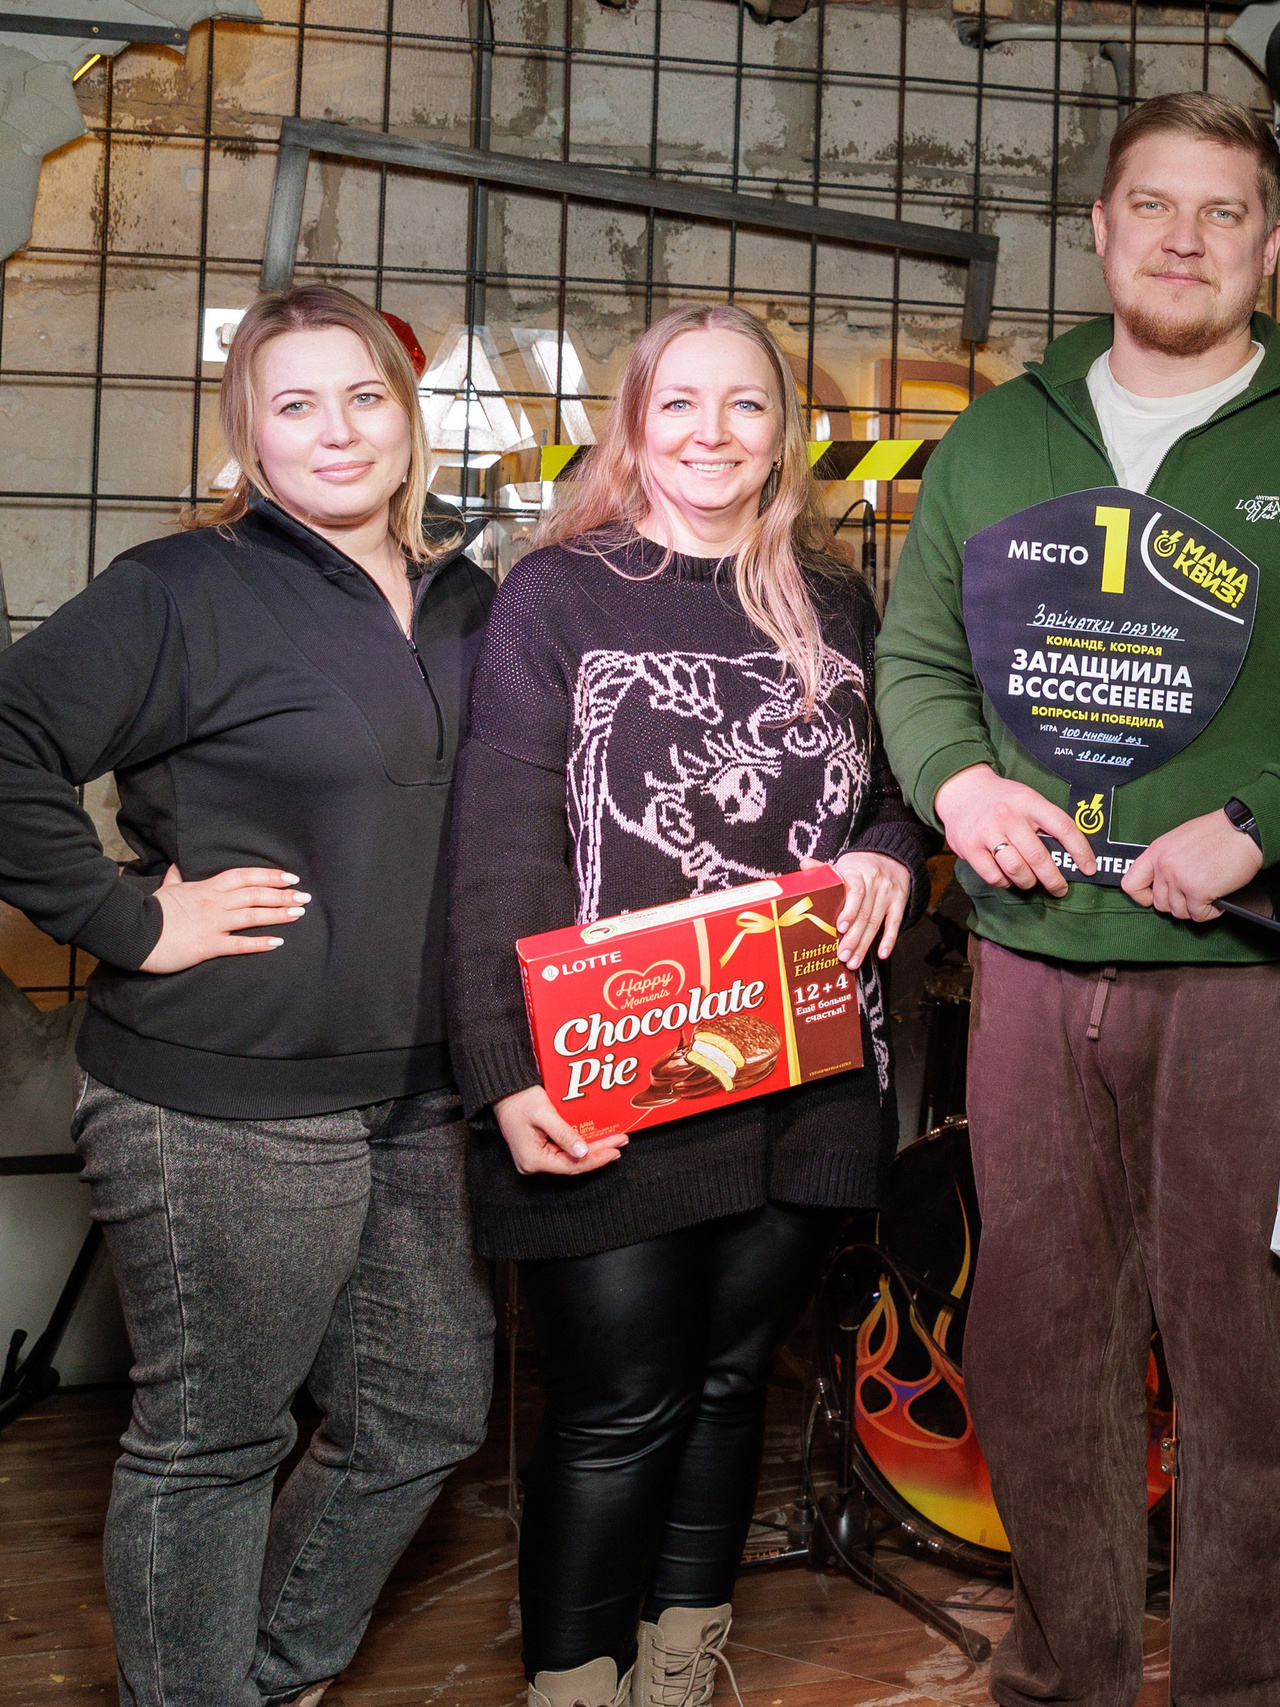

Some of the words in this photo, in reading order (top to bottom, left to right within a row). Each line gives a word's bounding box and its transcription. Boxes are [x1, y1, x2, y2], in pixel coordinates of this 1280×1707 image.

[1235, 499, 1264, 512] LOS
[1007, 539, 1089, 566] МЕСТО
[1094, 505, 1131, 594] 1
[1182, 537, 1249, 594] МАМА
[1172, 552, 1245, 609] КВИЗ!
[1046, 635, 1107, 652] КОМАНДЕ,
[1110, 642, 1163, 656] КОТОРАЯ
[1011, 648, 1193, 688] ЗАТАЩИИЛА
[1008, 674, 1193, 714] ВСССССЕЕЕЕЕЕ
[1031, 705, 1088, 721] ВОПРОСЫ
[1090, 711, 1100, 722] И
[1101, 713, 1164, 729] ПОБЕДИЛА
[1040, 724, 1058, 733] ИГРА
[1061, 726, 1080, 738] 100
[1054, 747, 1074, 757] ДАТА
[793, 938, 839, 963] Limited
[562, 950, 622, 976] LOTTE
[794, 956, 839, 978] Edition
[616, 972, 674, 997] Happy
[620, 988, 670, 1010] Moments
[818, 993, 852, 1009] больше
[553, 979, 765, 1057] Chocolate
[805, 1004, 846, 1024] счастья!
[561, 1052, 639, 1101] Pie
